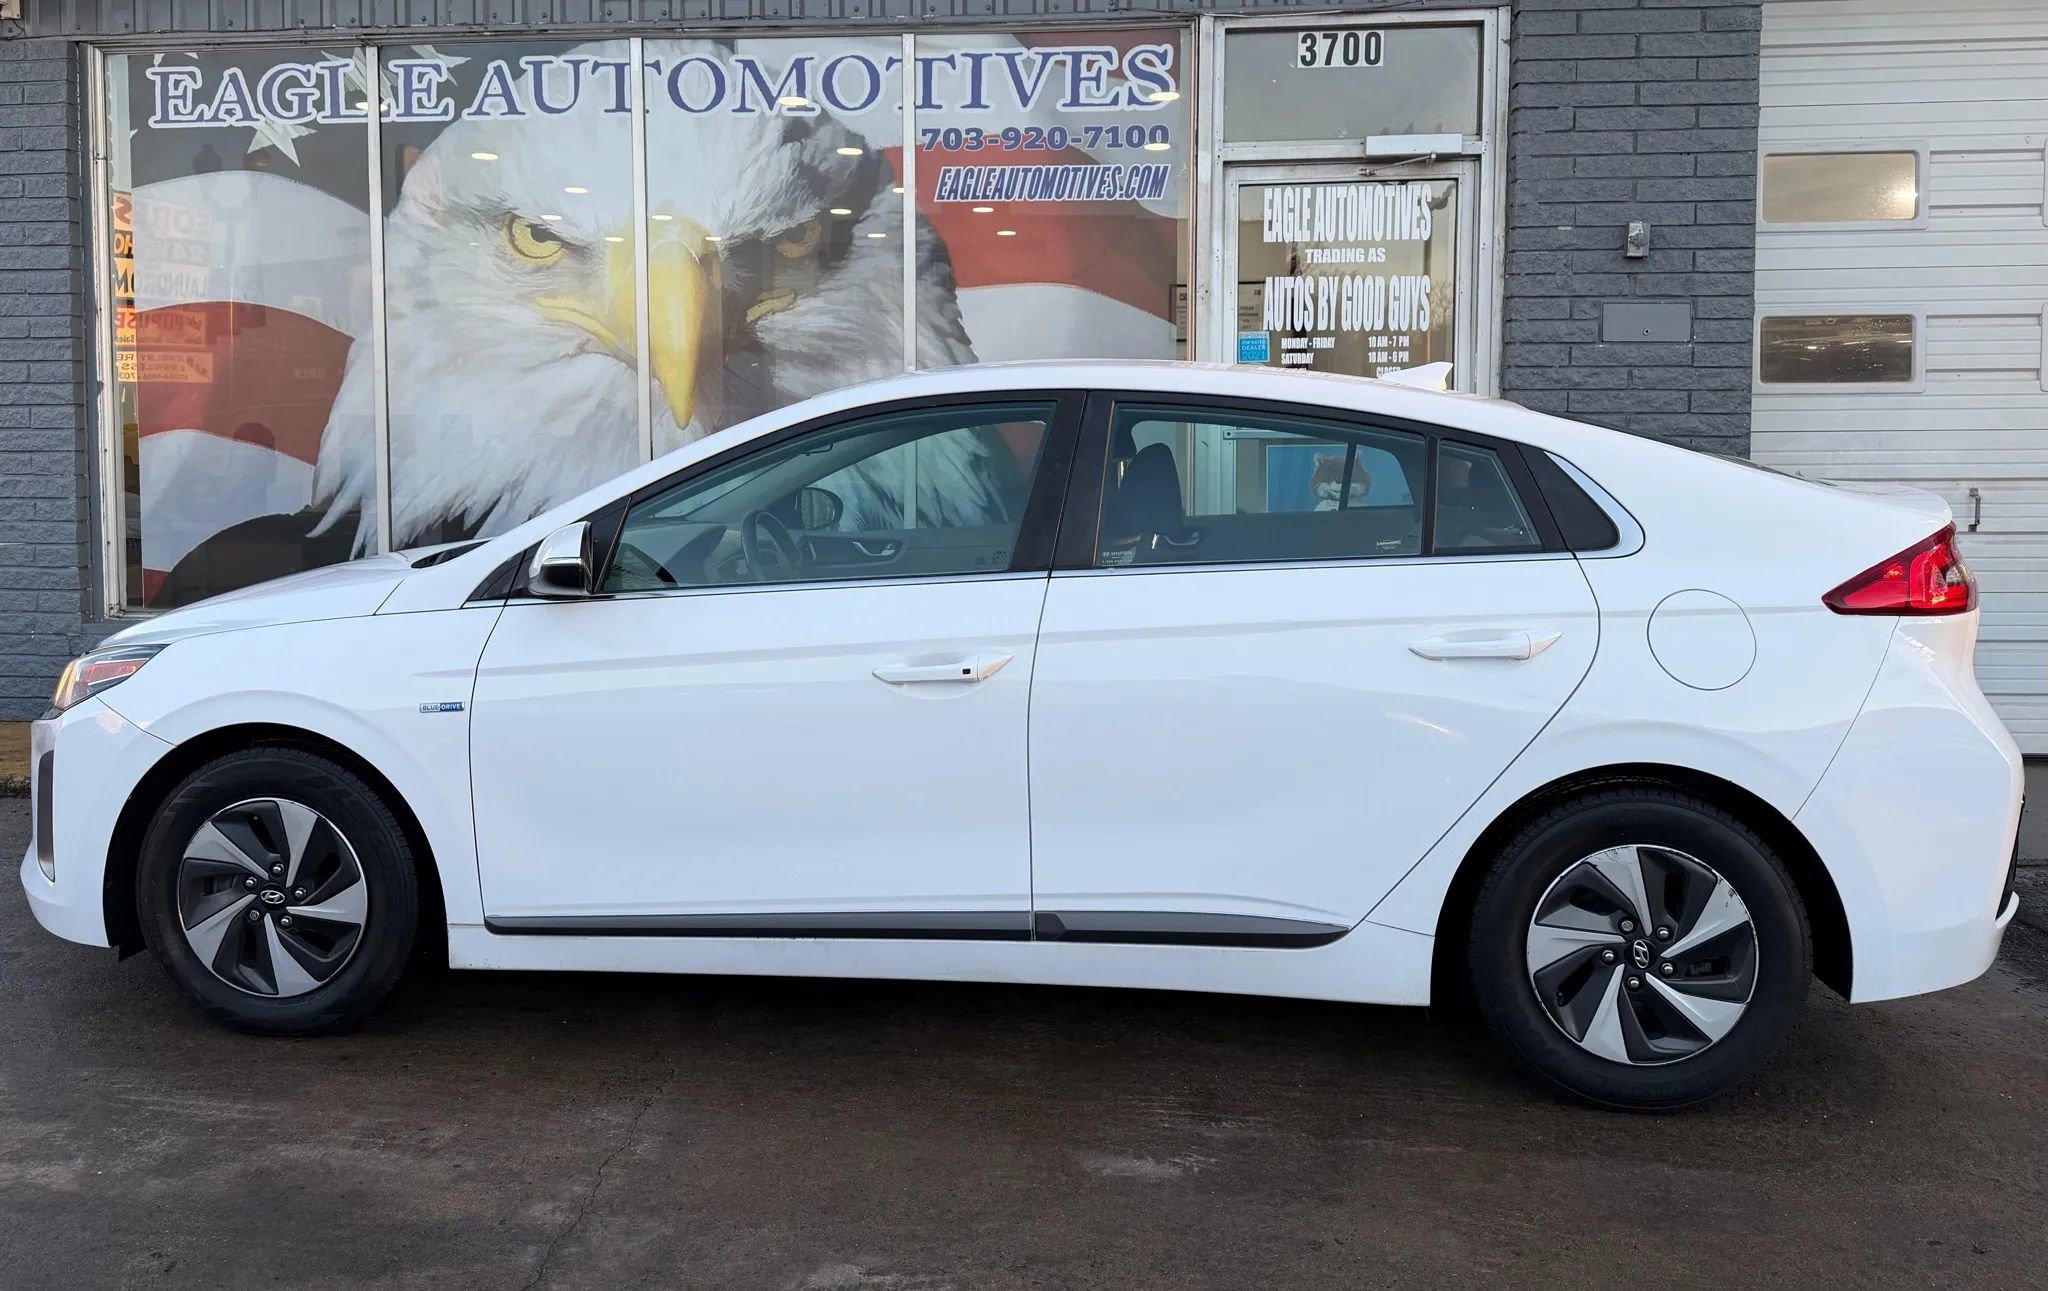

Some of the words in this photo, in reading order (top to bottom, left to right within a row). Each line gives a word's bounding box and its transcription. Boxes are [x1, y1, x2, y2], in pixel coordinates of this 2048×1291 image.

[1300, 31, 1382, 67] 3700
[147, 60, 454, 127] EAGLE
[466, 43, 1176, 121] AUTOMOTIVES
[921, 124, 1170, 151] 703-920-7100
[935, 164, 1171, 202] EAGLEAUTOMOTIVES.COM
[1263, 187, 1311, 243] EAGLE
[1313, 183, 1432, 243] AUTOMOTIVES
[1305, 248, 1365, 264] TRADING
[1367, 247, 1386, 263] AS
[1263, 275, 1315, 331] AUTOS
[1317, 275, 1340, 331] BY
[1341, 274, 1386, 332] GOOD
[1388, 274, 1431, 332] GUYS
[1281, 337, 1308, 349] MONDAY
[1313, 337, 1335, 349] FRIDAY
[1368, 336, 1377, 348] 10
[1377, 336, 1388, 348] AM
[1392, 336, 1397, 347] 7
[1398, 335, 1410, 347] PM
[1241, 350, 1266, 360] 2021
[1281, 352, 1314, 364] SATURDAY
[1368, 351, 1377, 363] 10
[1377, 351, 1388, 363] AM
[1392, 351, 1397, 362] 6
[1398, 350, 1410, 362] PM
